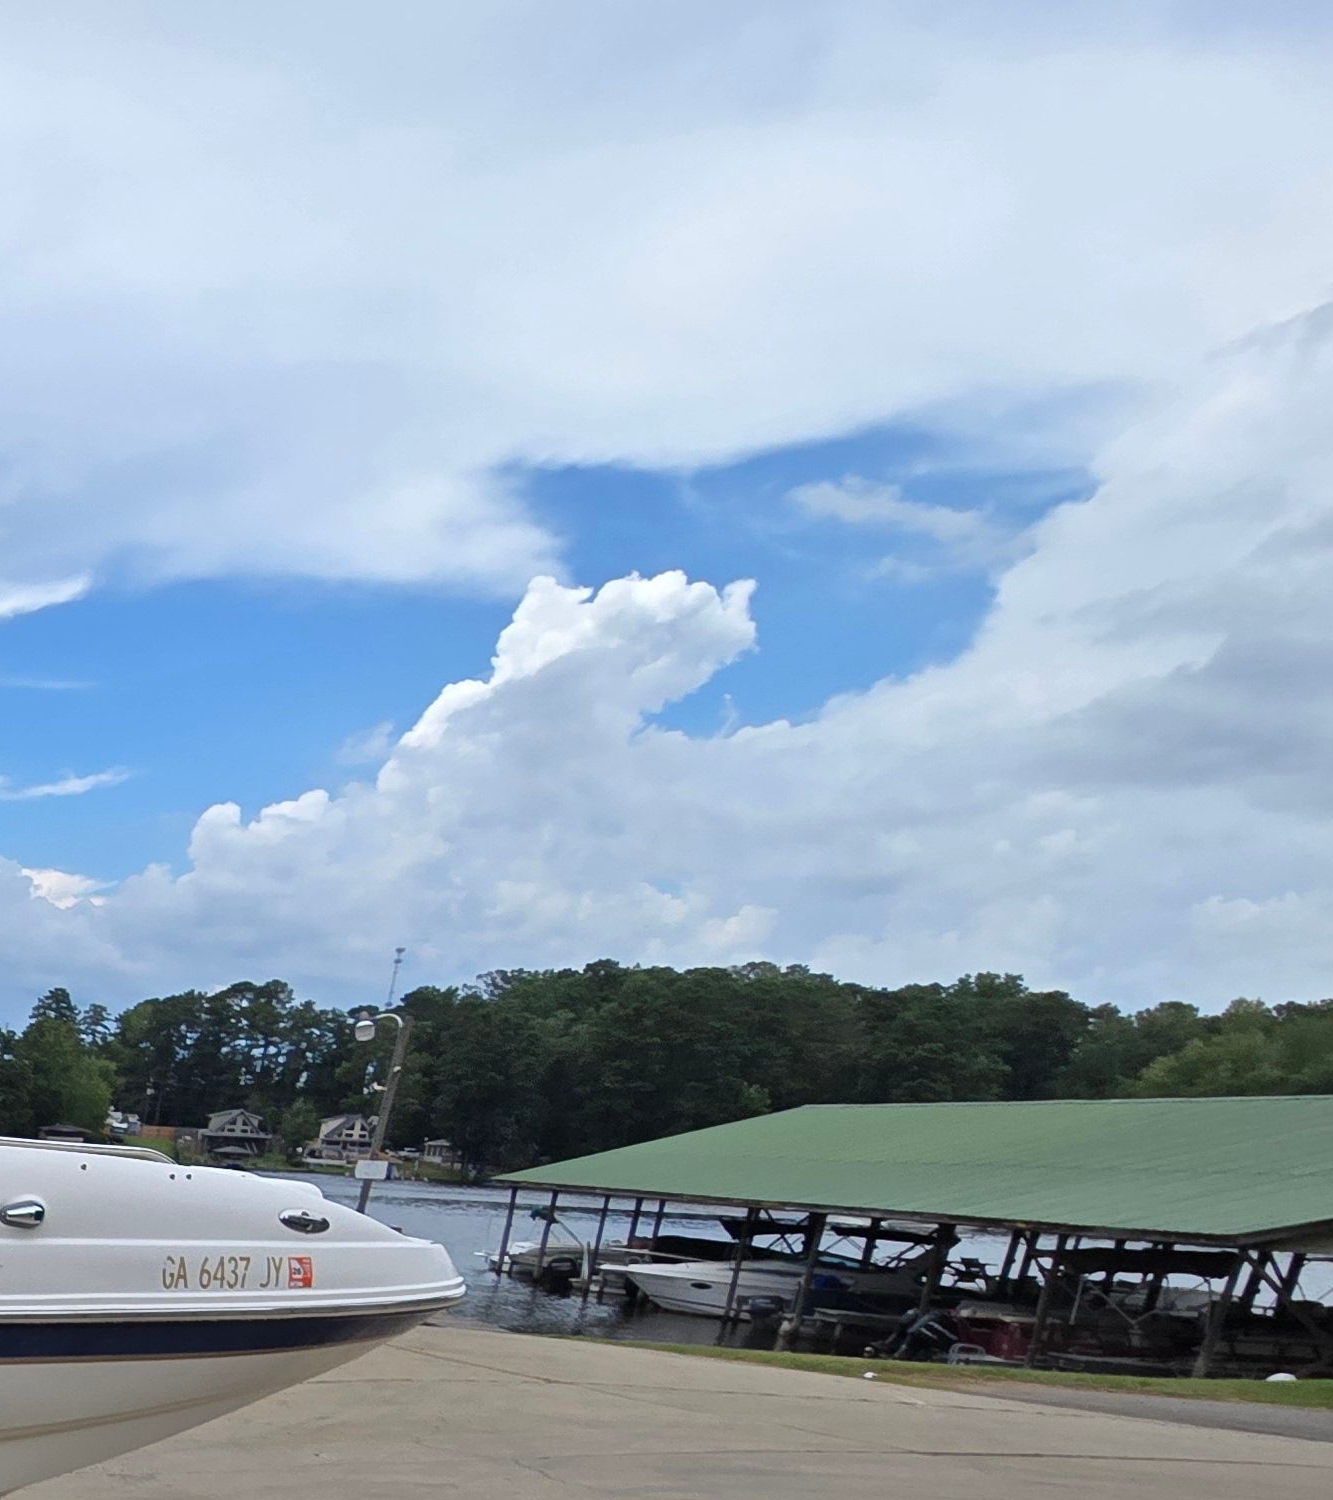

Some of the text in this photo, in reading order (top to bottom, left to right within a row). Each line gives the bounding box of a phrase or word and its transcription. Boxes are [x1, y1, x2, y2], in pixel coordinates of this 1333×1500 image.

[162, 1255, 283, 1289] GA 6437 JY
